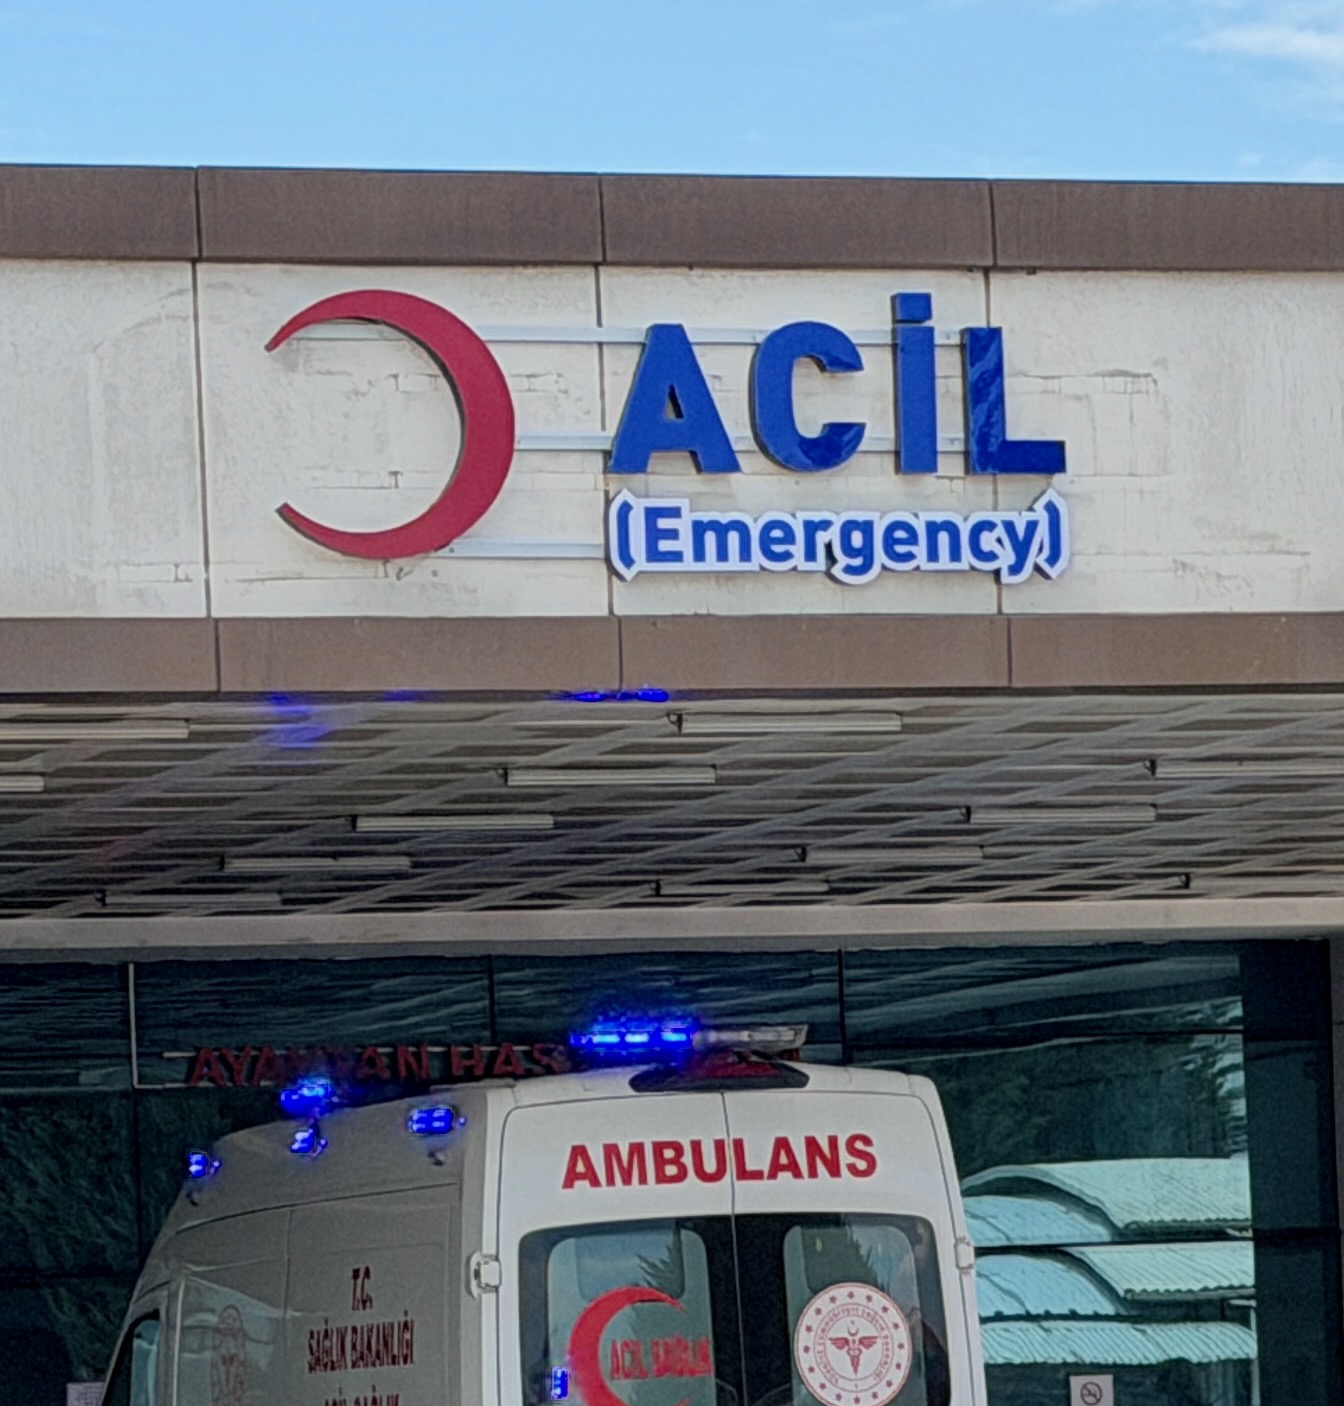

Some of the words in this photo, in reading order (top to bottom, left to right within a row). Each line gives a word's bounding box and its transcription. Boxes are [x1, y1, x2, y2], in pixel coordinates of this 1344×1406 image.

[605, 292, 1067, 475] ACİL
[612, 492, 1068, 582] (Emergency)
[562, 1134, 877, 1189] AMBULANS
[308, 1318, 348, 1374] SAĞLIK
[351, 1309, 415, 1369] BAKANLIĞI
